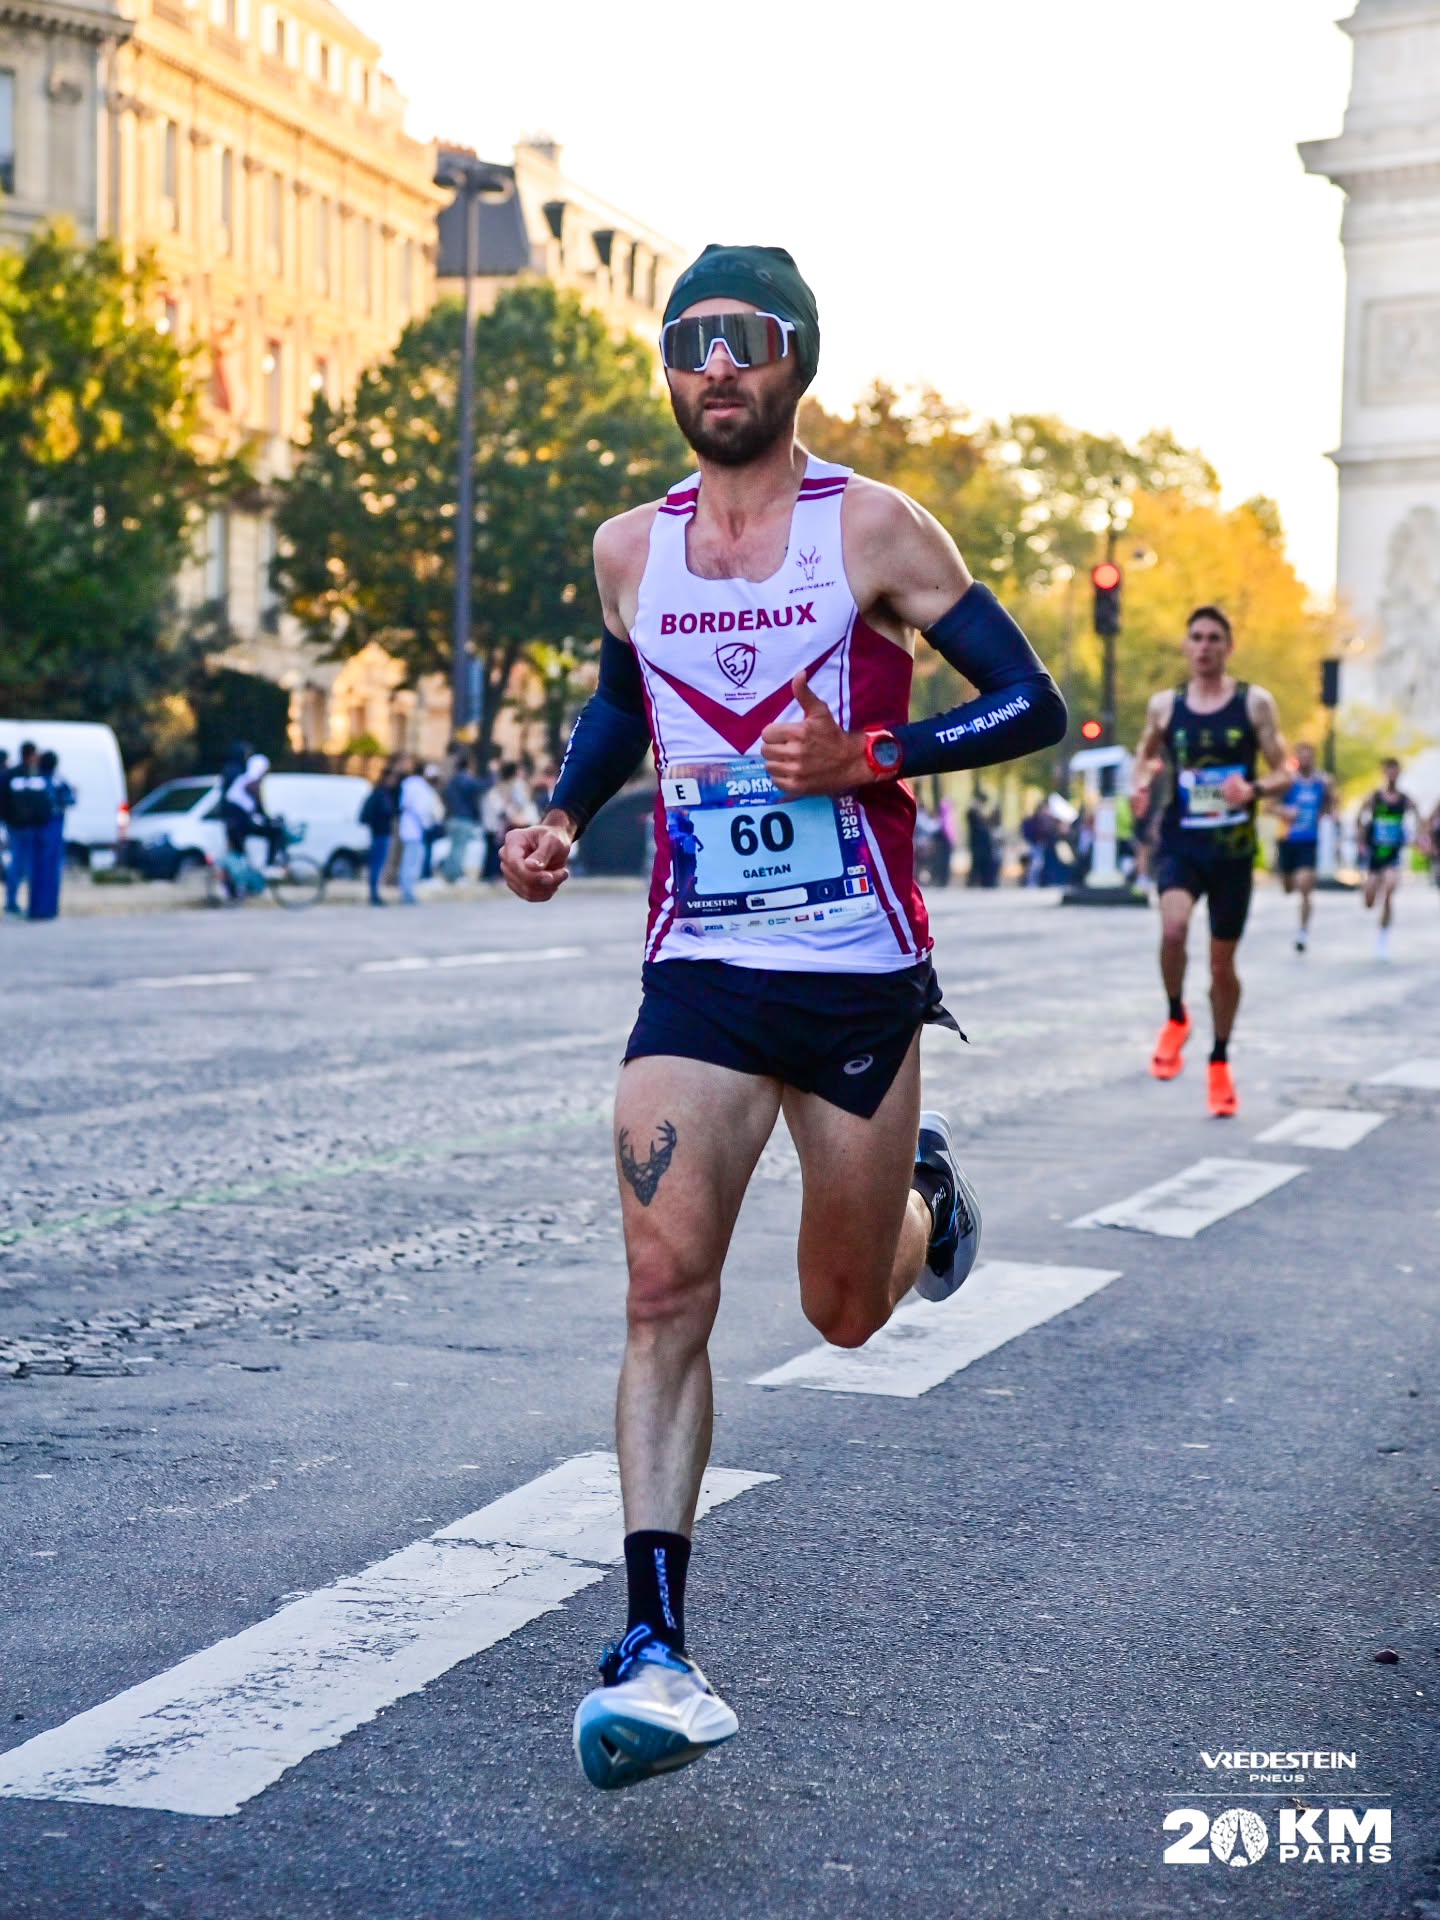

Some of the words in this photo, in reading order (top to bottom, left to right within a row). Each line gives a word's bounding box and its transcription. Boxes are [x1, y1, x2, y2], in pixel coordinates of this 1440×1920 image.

[660, 601, 817, 635] BORDEAUX
[675, 784, 686, 800] E
[840, 796, 854, 807] 12
[841, 815, 858, 828] 20
[730, 811, 795, 856] 60
[843, 827, 860, 840] 25
[687, 898, 738, 909] VREDESTEIN
